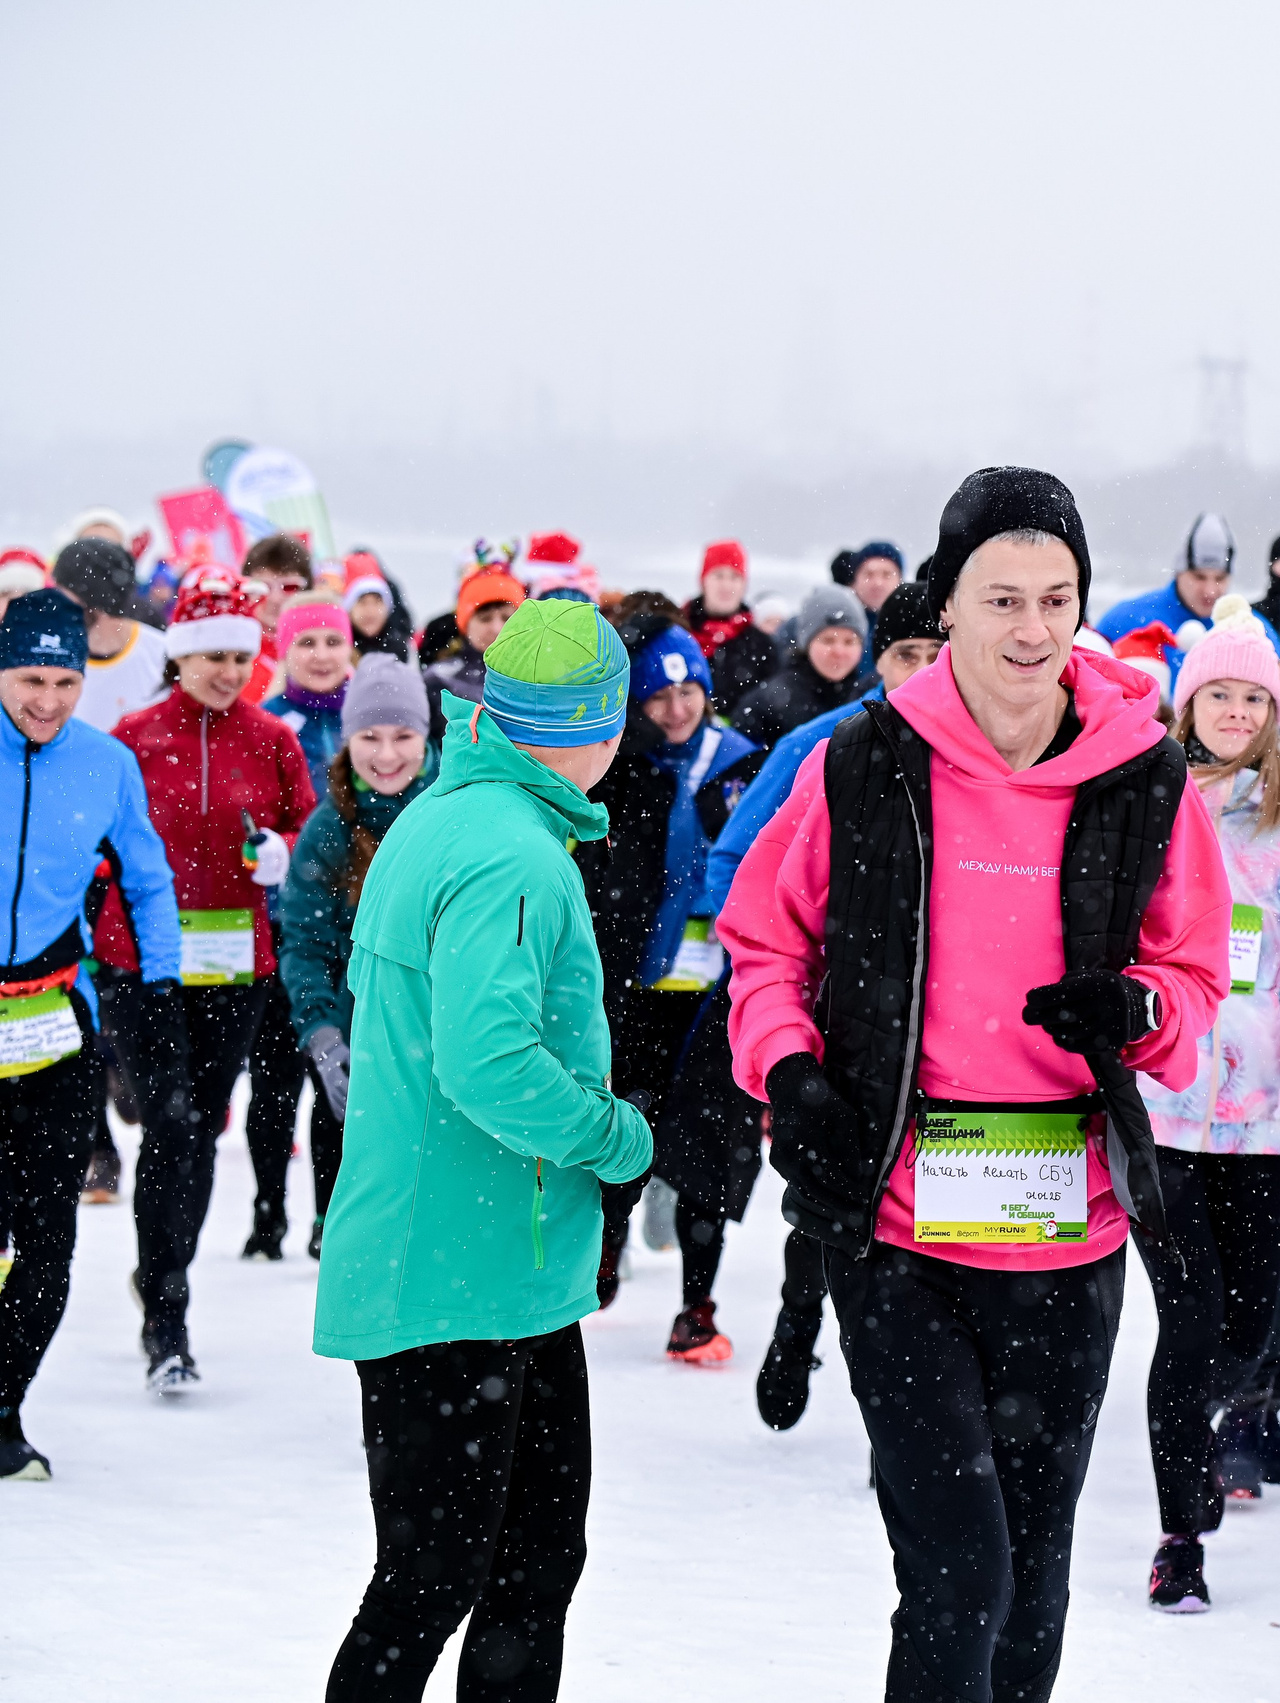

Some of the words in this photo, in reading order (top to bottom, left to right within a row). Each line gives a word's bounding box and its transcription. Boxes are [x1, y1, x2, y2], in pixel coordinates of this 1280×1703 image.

[958, 859, 1001, 874] МЕЖДУ
[1004, 864, 1039, 876] НАМИ
[1041, 866, 1060, 877] БЕГ
[1039, 1163, 1074, 1187] СБУ
[1009, 1204, 1029, 1212] БЕГУ
[1016, 1211, 1055, 1220] ОБЕЩАЮ
